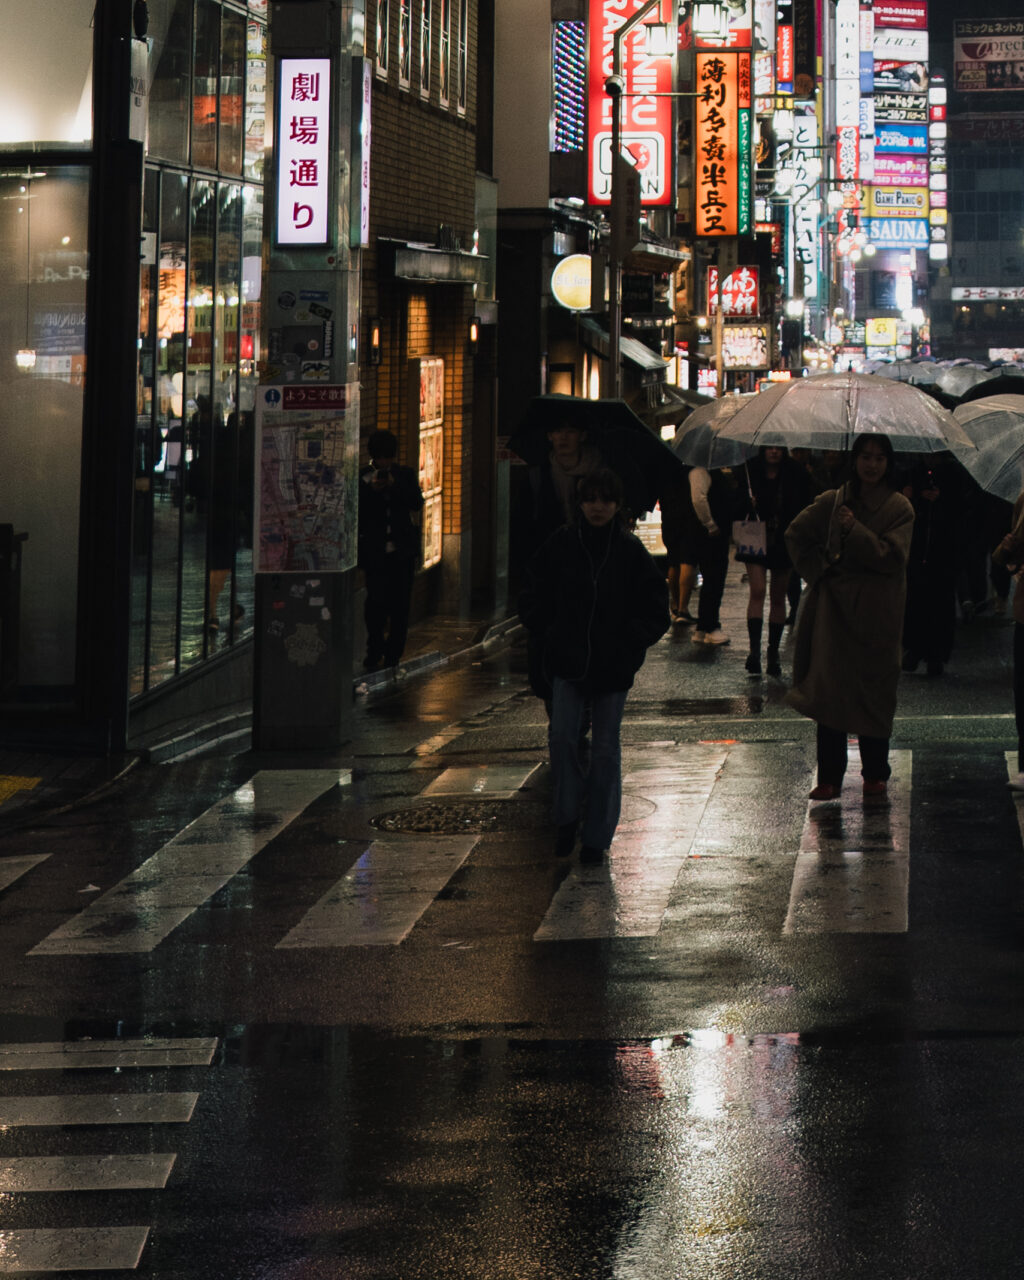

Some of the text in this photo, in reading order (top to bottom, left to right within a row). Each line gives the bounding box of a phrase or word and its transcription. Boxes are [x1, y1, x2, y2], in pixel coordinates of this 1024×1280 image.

[289, 72, 321, 230] 劇場通り
[869, 220, 929, 241] SAUNA
